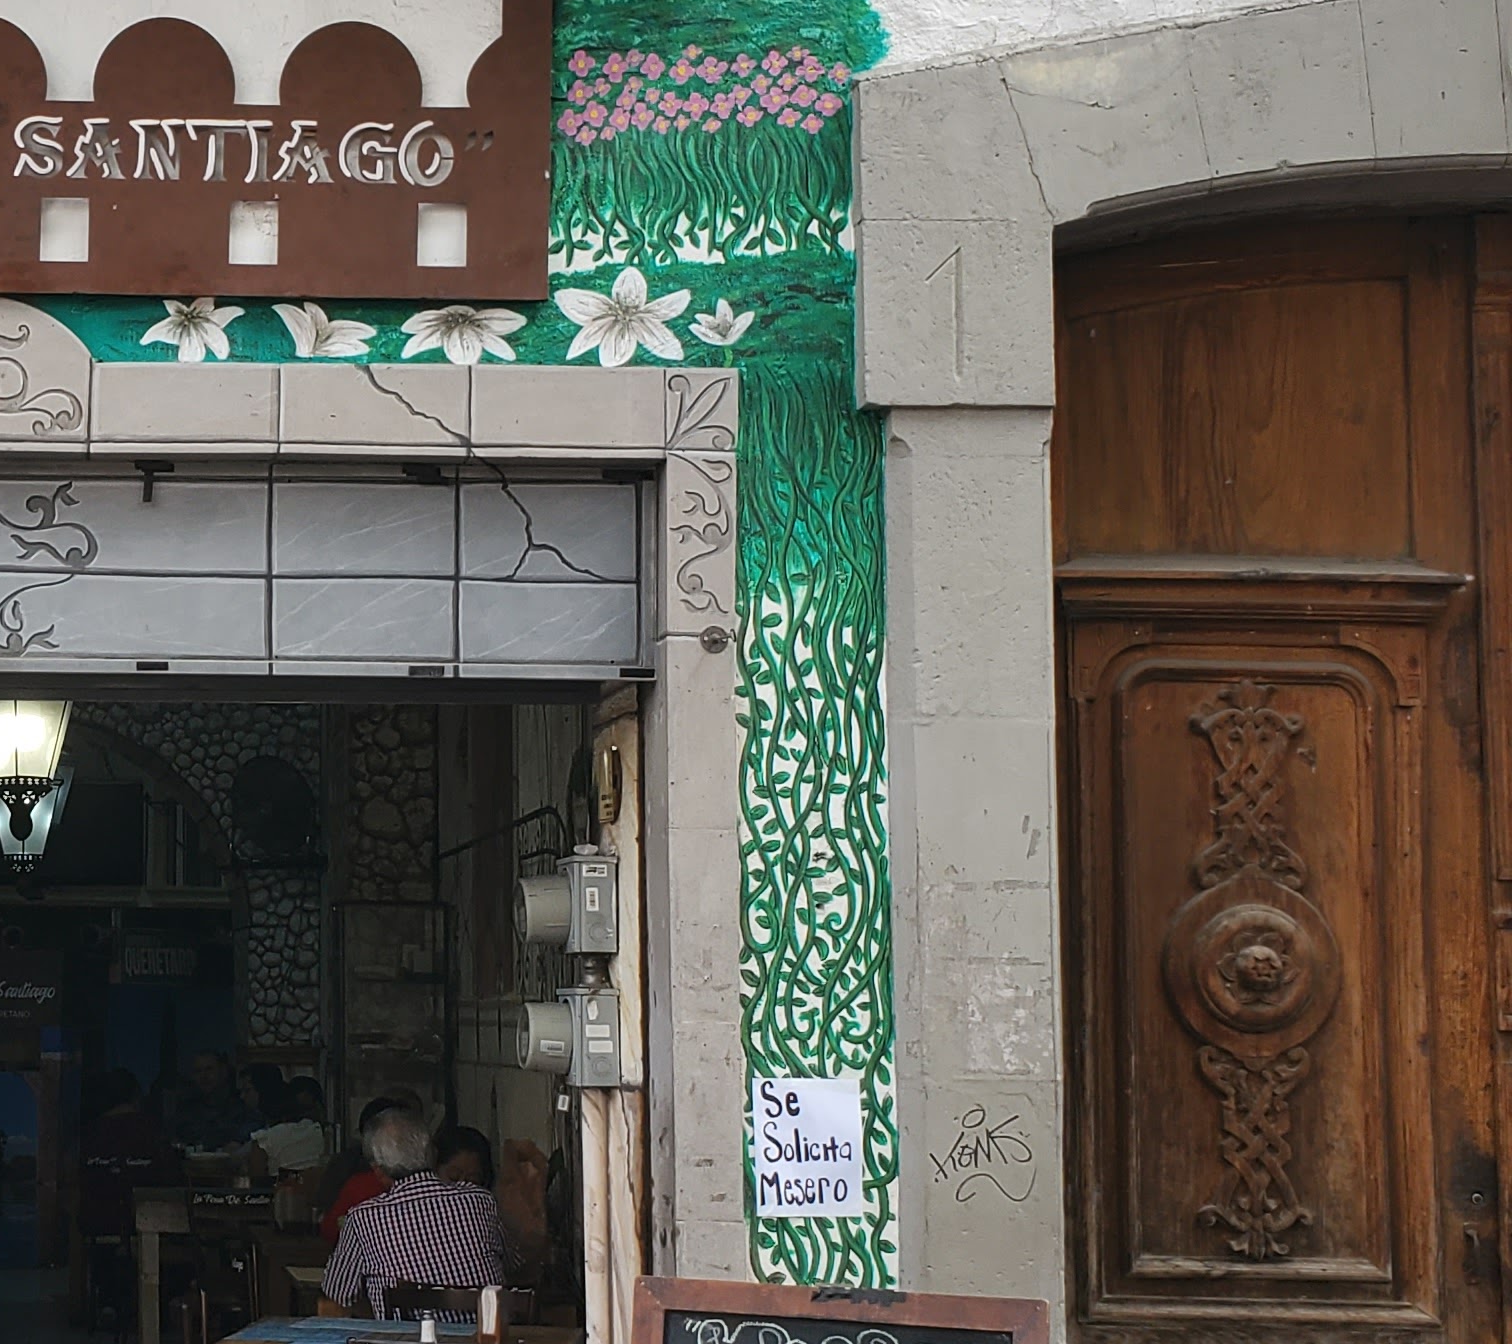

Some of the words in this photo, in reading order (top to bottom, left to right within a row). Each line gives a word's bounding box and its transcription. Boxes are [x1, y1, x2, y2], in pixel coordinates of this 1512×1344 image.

[760, 1080, 801, 1118] Se
[763, 1121, 852, 1164] Solicita
[760, 1171, 848, 1206] Mesero
